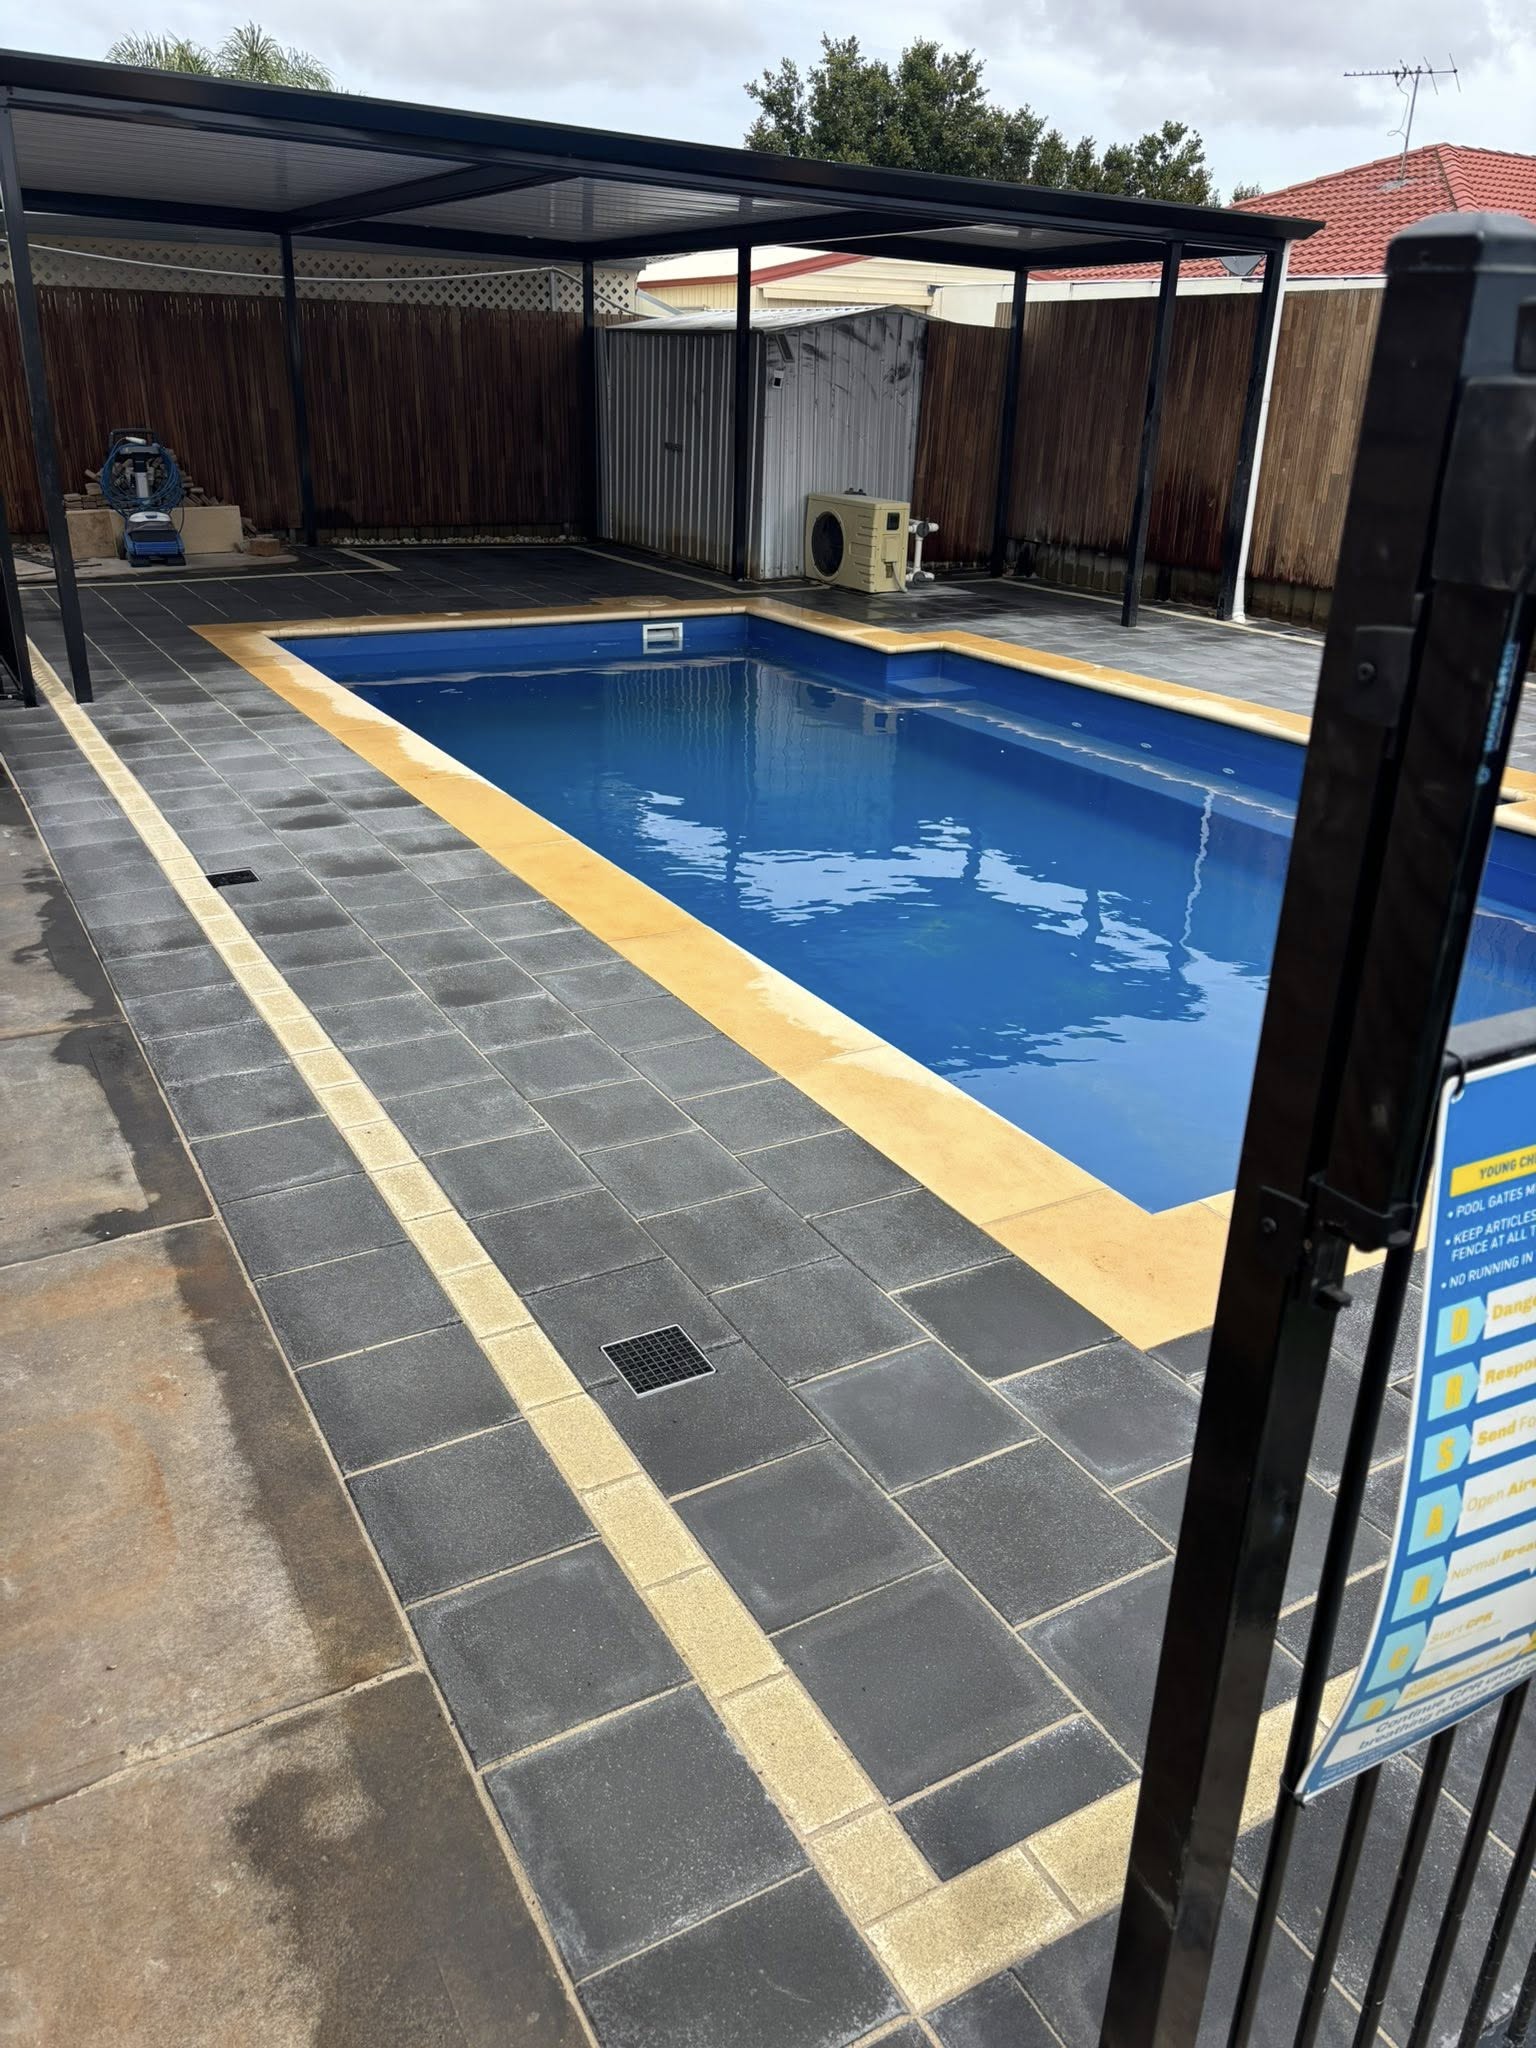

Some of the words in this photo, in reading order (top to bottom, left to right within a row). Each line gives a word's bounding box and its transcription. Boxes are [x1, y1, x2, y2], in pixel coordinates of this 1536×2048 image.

[1480, 1159, 1516, 1180] YOUNG
[1456, 1200, 1485, 1218] POOL
[1488, 1187, 1523, 1208] GATES
[1453, 1225, 1483, 1245] KEEP
[1484, 1209, 1536, 1235] ARTICLES
[1451, 1239, 1488, 1262] FENCE
[1490, 1234, 1505, 1250] AT
[1506, 1228, 1527, 1244] ALL
[1449, 1273, 1466, 1288] NO
[1468, 1255, 1519, 1282] RUNNING
[1520, 1251, 1534, 1265] IN
[1477, 1418, 1516, 1445] Send
[1438, 1438, 1455, 1471] S
[1467, 1490, 1504, 1512] Open
[1452, 1553, 1500, 1579] Normal
[1376, 1698, 1445, 1733] Continue
[1450, 1679, 1489, 1701] CPR
[1359, 1712, 1433, 1750] breathing
